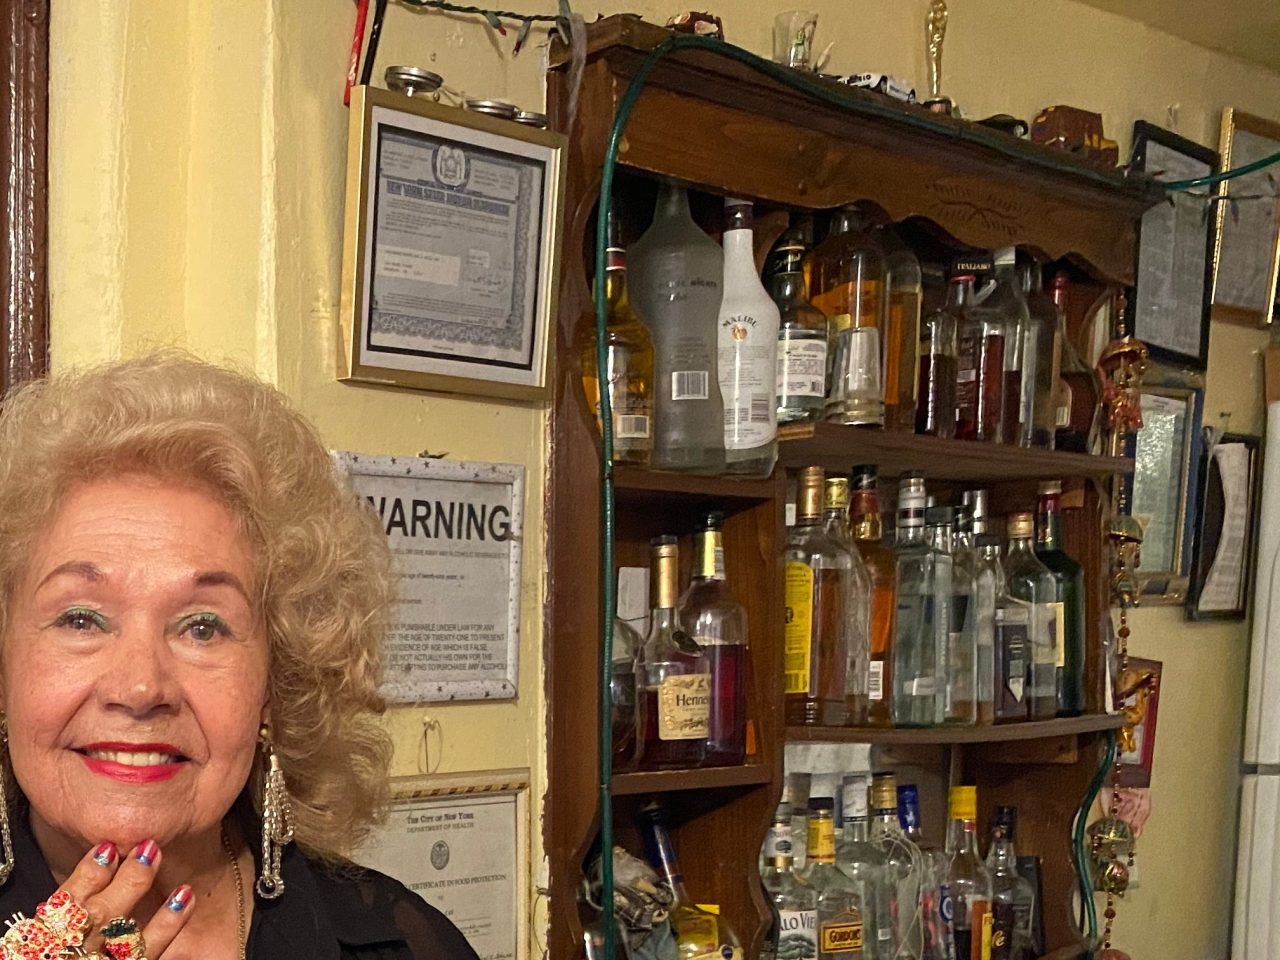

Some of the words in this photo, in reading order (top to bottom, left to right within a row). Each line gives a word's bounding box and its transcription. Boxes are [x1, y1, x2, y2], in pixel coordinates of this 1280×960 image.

[722, 315, 757, 328] MALIBU
[676, 693, 709, 706] Henne
[406, 824, 442, 833] DEPARTMENT
[779, 917, 799, 931] ALO
